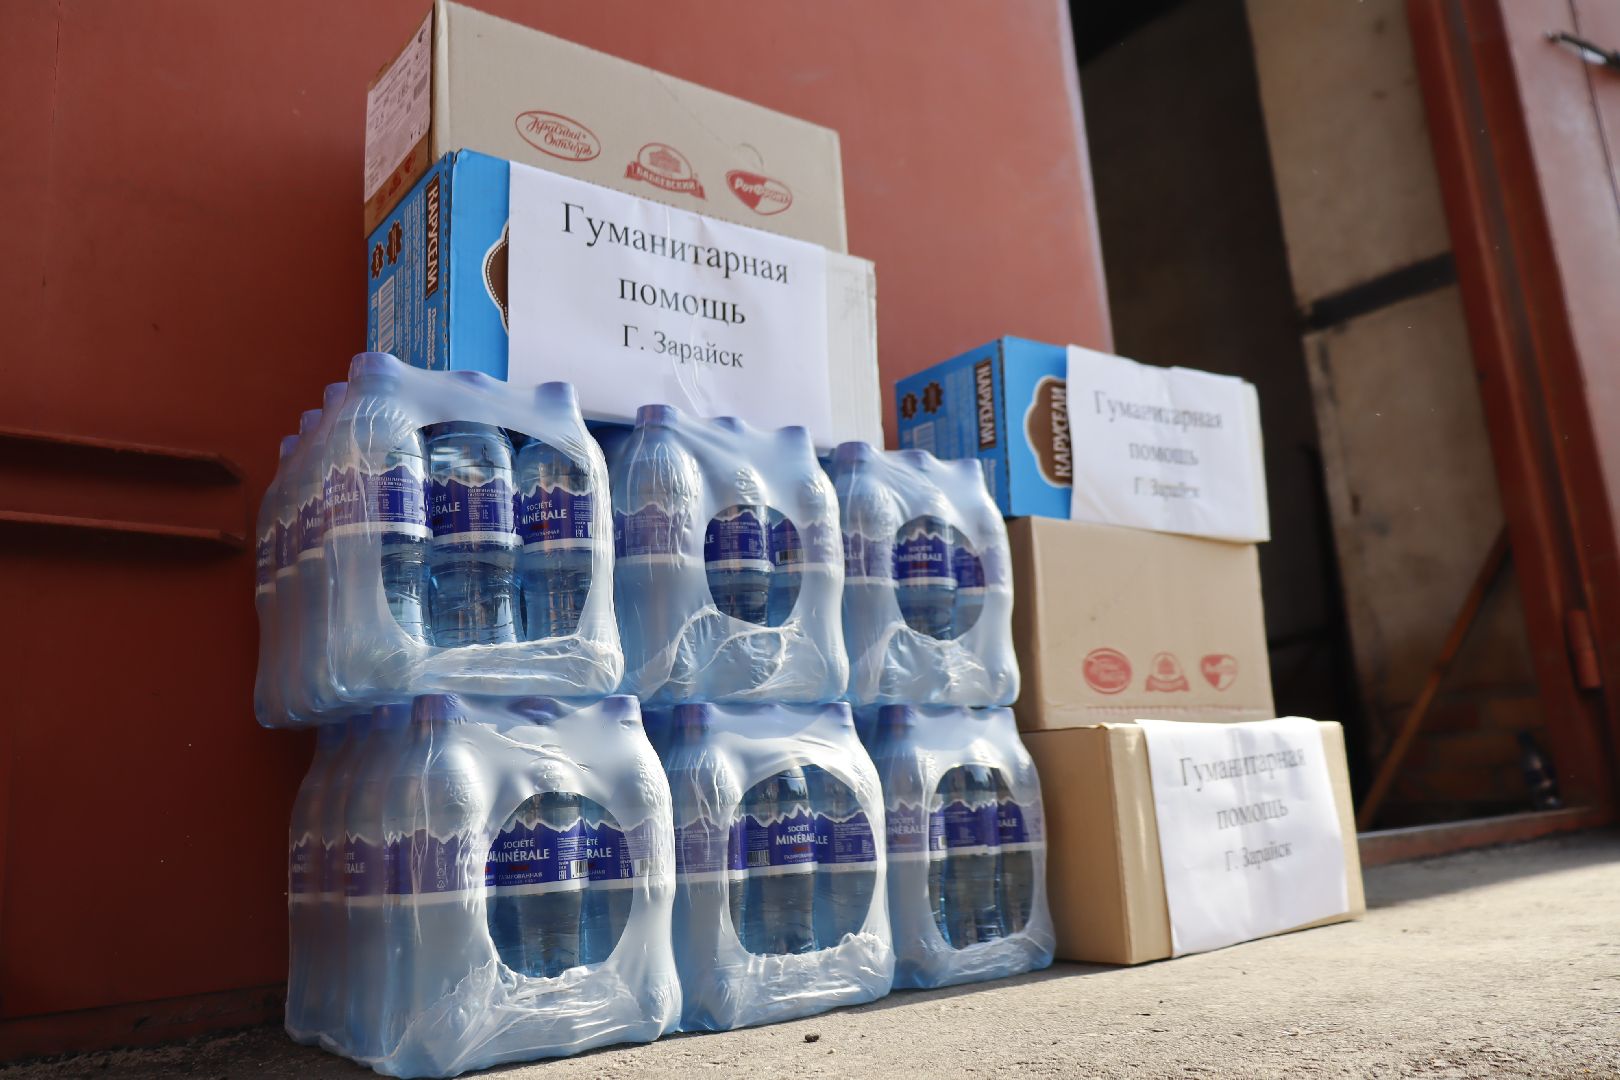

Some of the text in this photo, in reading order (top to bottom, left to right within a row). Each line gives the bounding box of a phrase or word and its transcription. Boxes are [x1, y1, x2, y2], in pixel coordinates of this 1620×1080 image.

[427, 186, 440, 289] КАРУСЕЛИ
[561, 201, 789, 284] Гуманитарная
[618, 278, 746, 326] помощь
[623, 324, 744, 369] Г. Зарайск
[977, 365, 994, 445] КАРУСЕЛИ
[1180, 748, 1307, 792] Гуманитарная
[1216, 798, 1290, 830] помощь
[503, 838, 535, 850] SOCIÉTÉ
[1241, 841, 1293, 871] Зарайск
